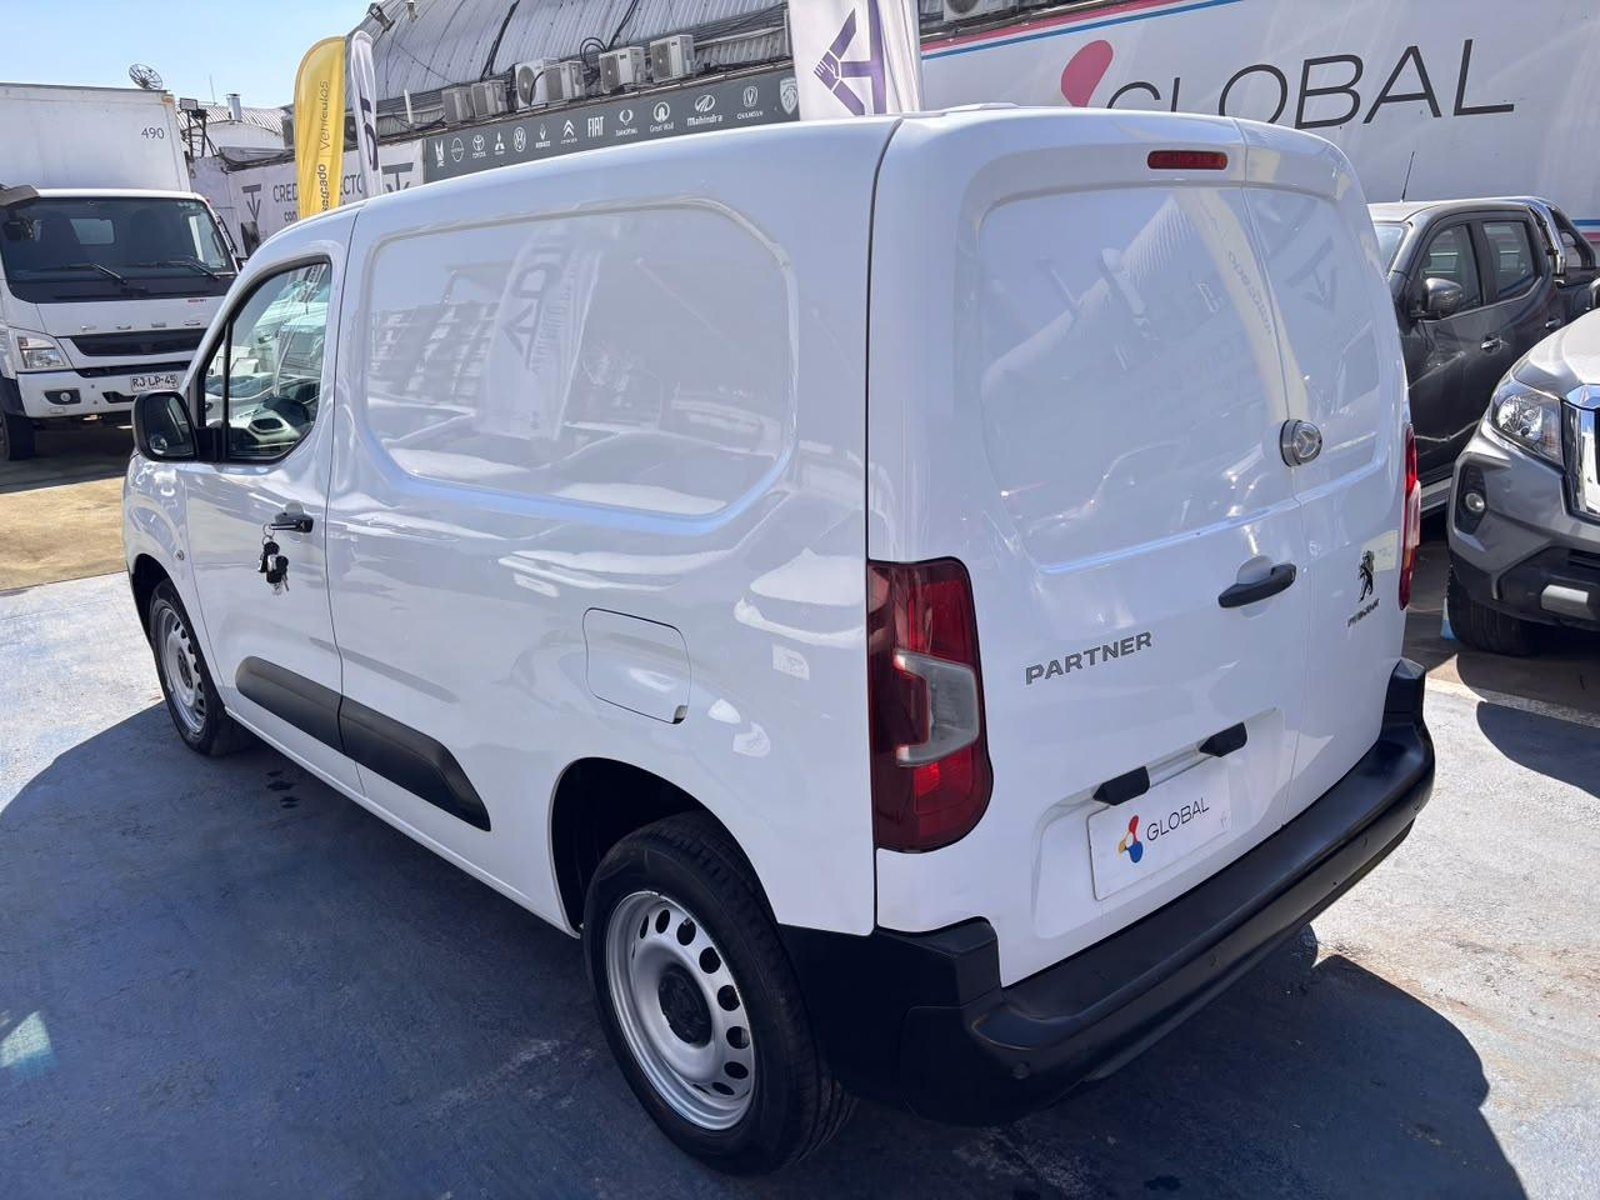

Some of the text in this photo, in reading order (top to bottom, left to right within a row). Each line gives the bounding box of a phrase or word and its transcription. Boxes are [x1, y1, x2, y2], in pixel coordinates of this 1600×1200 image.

[587, 116, 605, 138] FIAT
[687, 114, 723, 126] Mahindra
[141, 127, 165, 139] 490
[273, 182, 298, 203] CRED
[1025, 631, 1152, 686] PARTNER
[1146, 797, 1211, 841] GLOBAL
